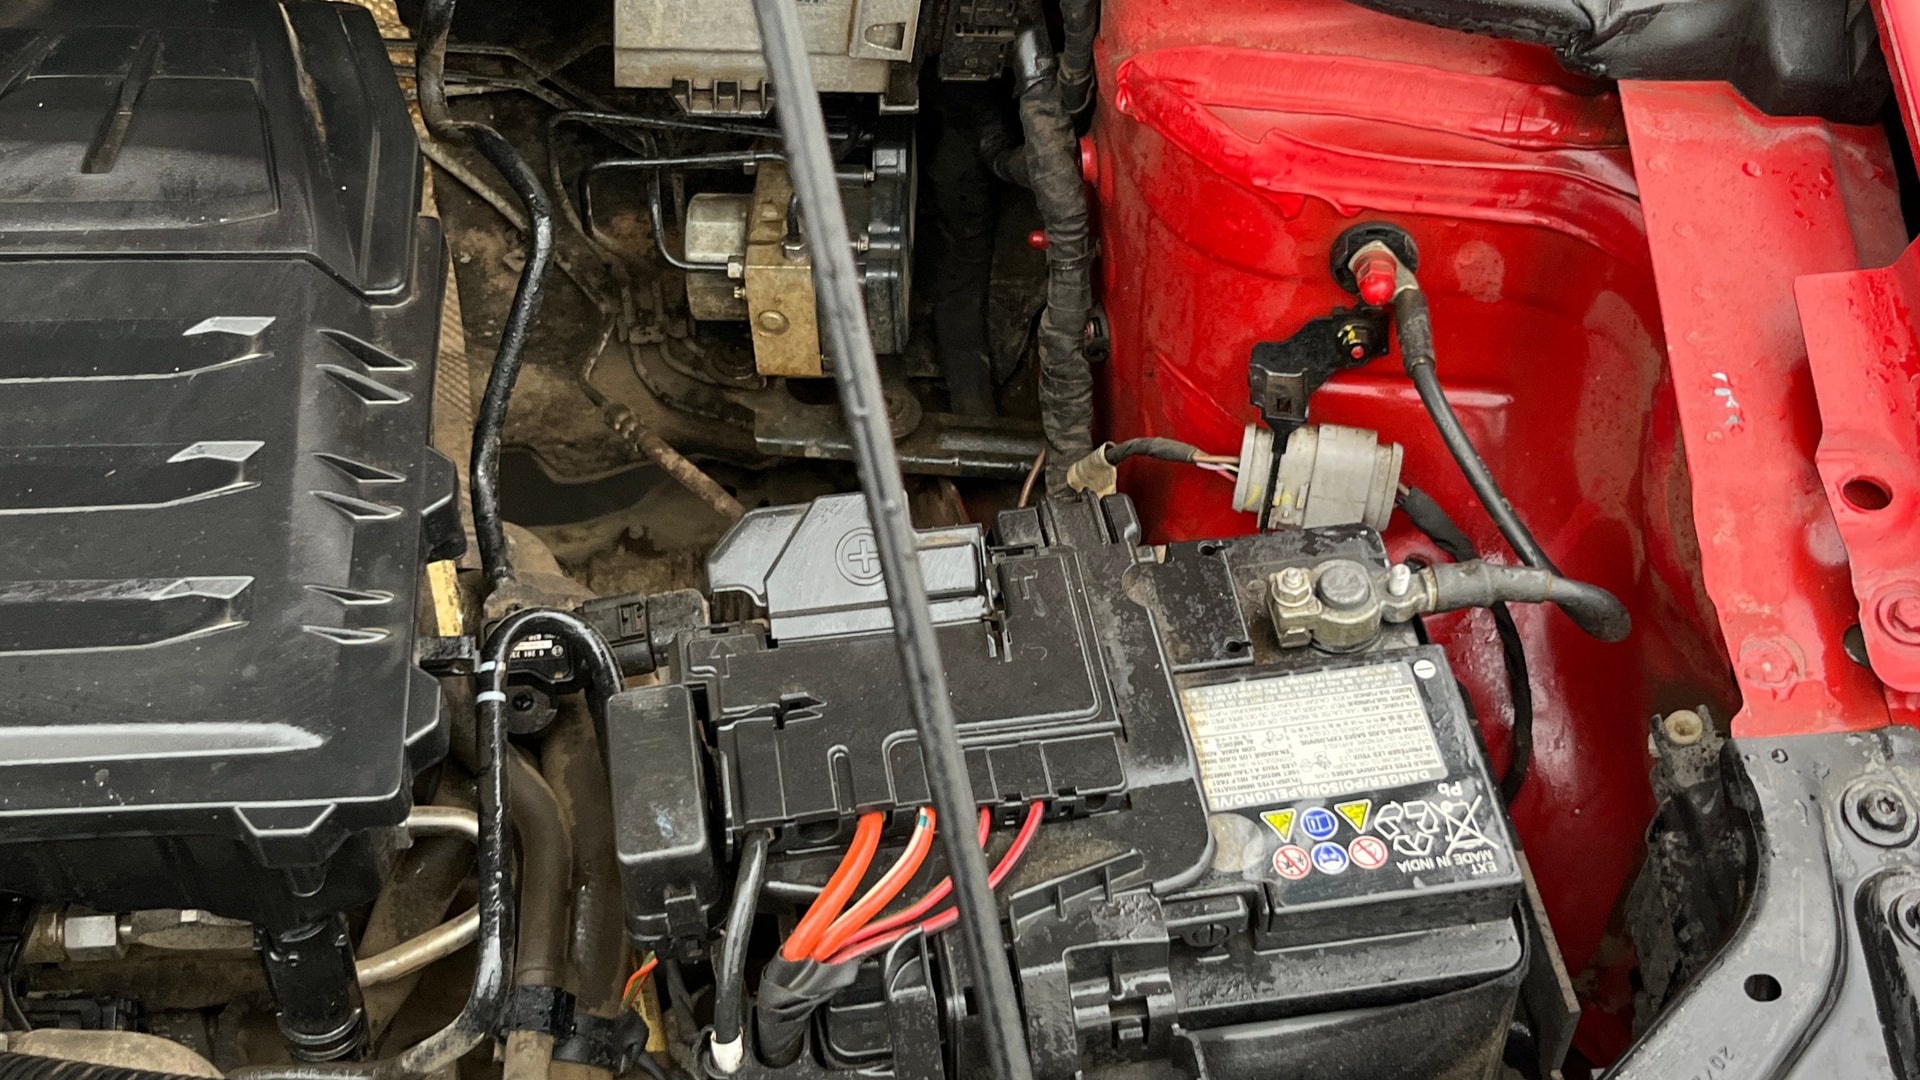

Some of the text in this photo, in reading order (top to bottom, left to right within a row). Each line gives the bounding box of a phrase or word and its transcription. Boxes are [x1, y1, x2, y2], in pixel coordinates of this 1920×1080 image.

[1437, 781, 1463, 797] Pb
[1395, 849, 1494, 873] MADE IN INDIA
[1471, 861, 1498, 875] EXT
